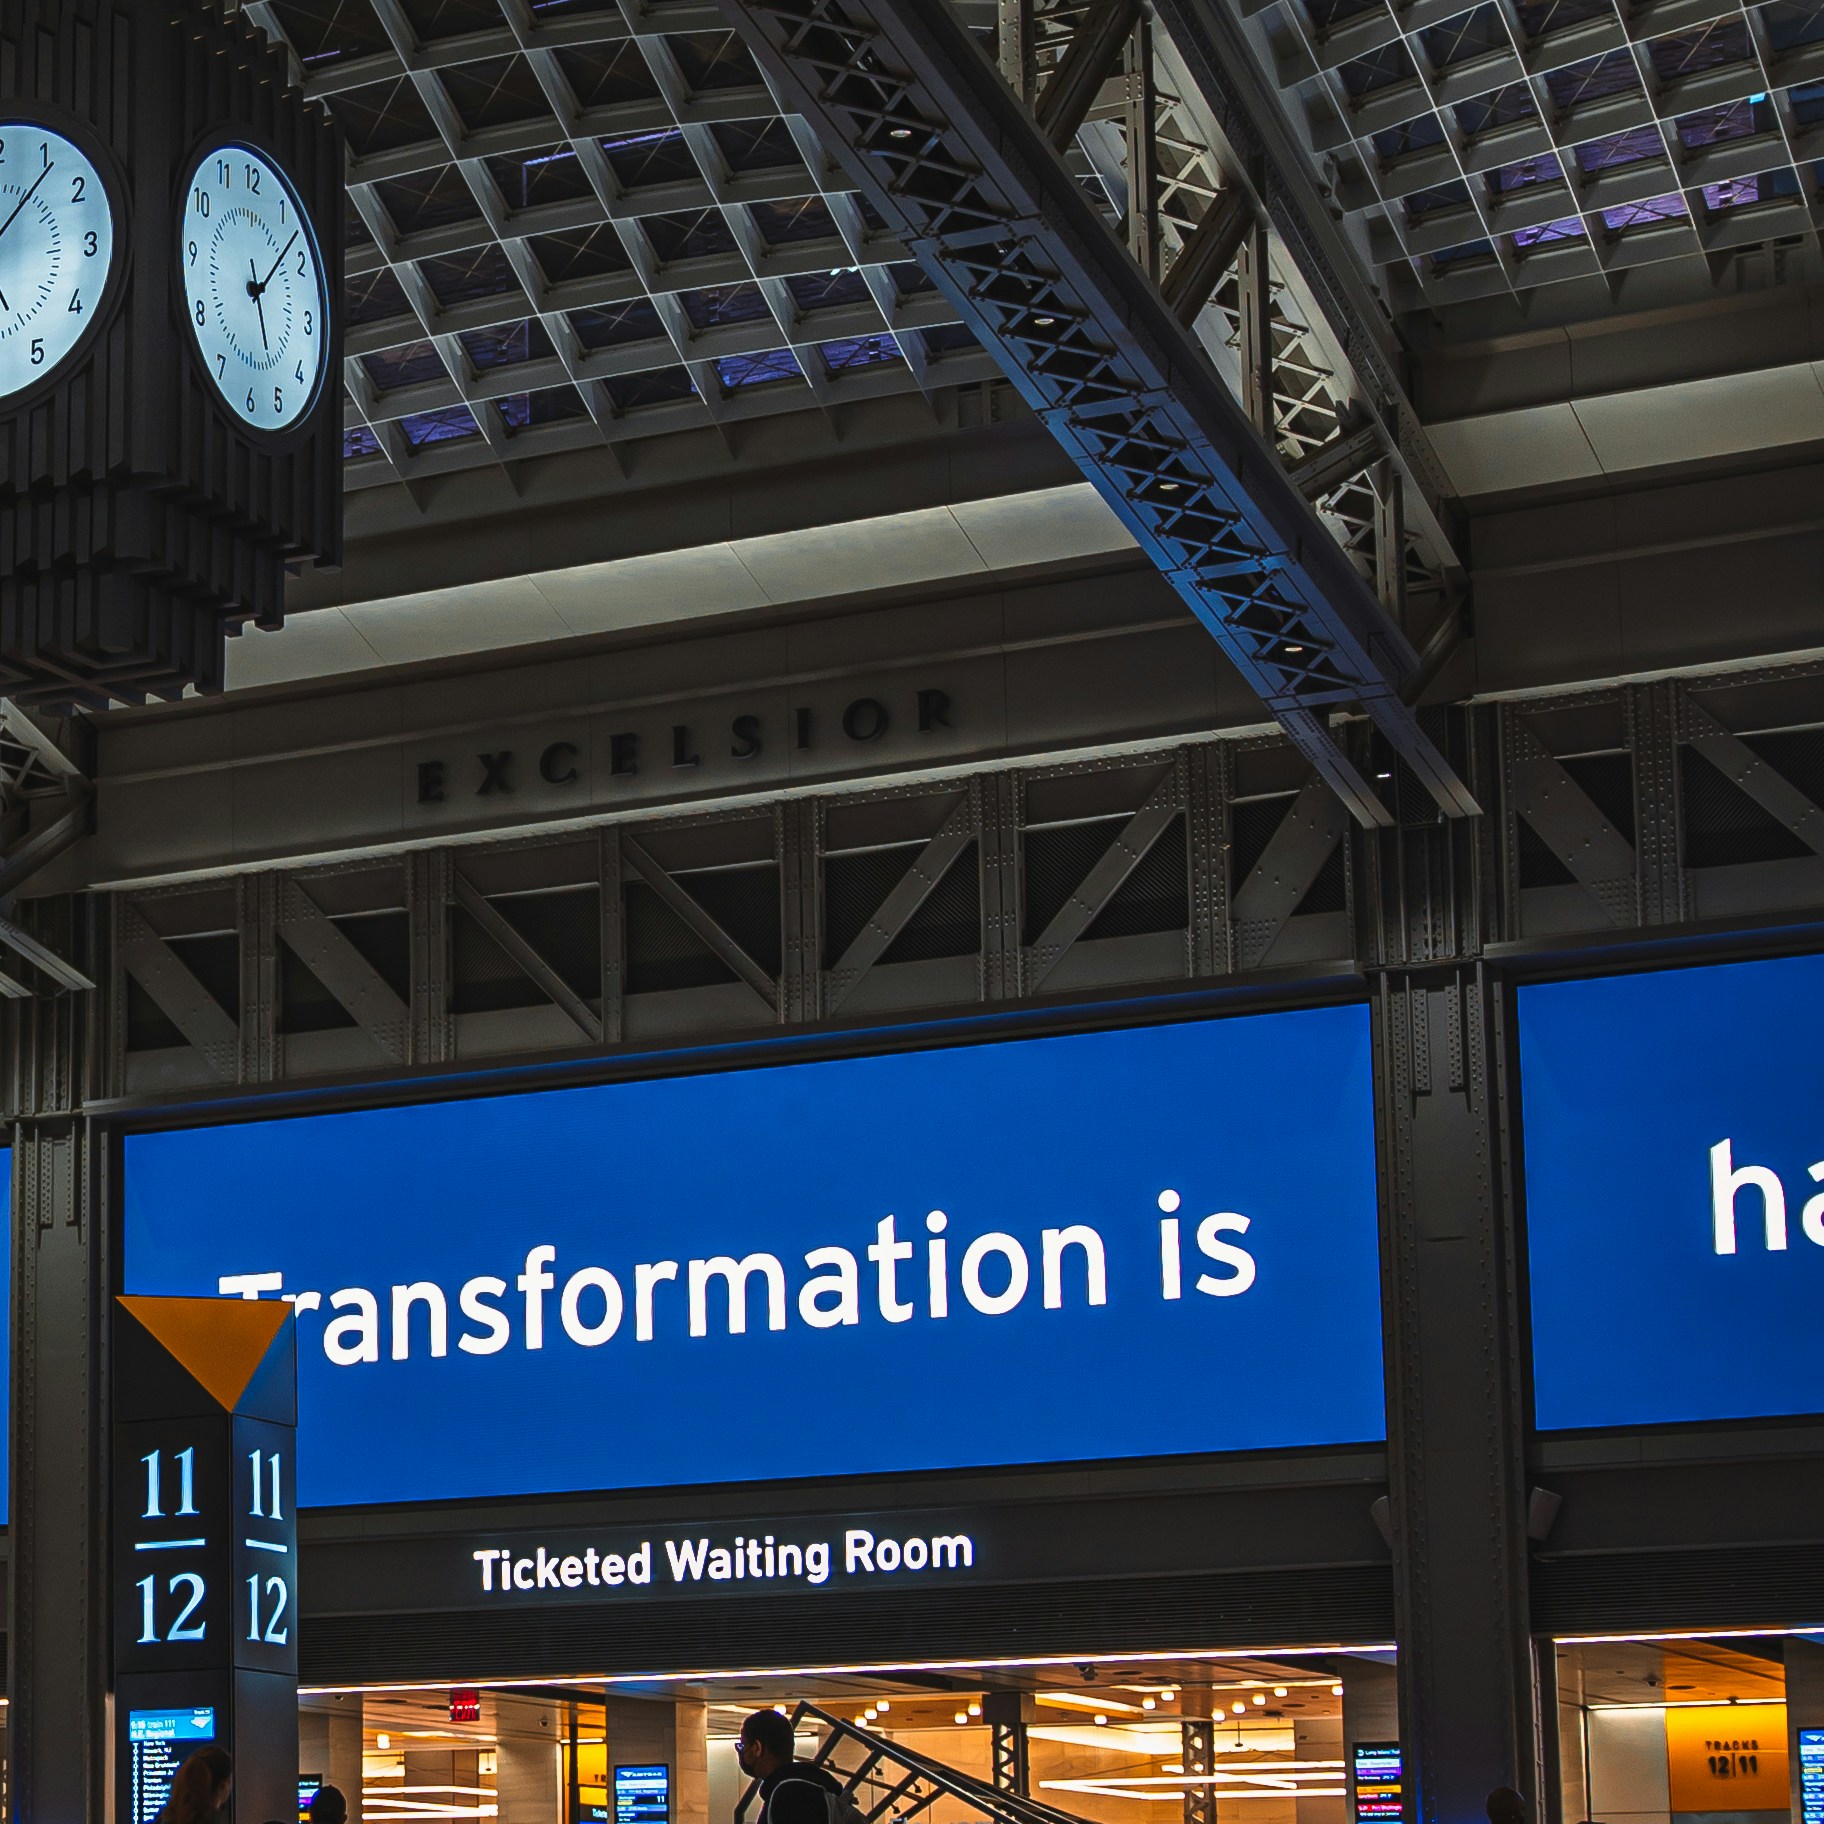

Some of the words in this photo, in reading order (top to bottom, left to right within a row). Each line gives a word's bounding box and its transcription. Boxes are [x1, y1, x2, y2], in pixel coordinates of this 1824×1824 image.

[39, 142, 48, 168] 1
[216, 159, 230, 189] 11
[244, 164, 261, 195] 12
[71, 176, 86, 203] 2
[193, 187, 210, 218] 10
[279, 199, 285, 224] 1
[83, 231, 98, 257] 3
[188, 241, 197, 266] 9
[296, 250, 306, 277] 2
[67, 288, 83, 314] 4
[195, 300, 205, 326] 8
[303, 310, 313, 336] 3
[30, 338, 44, 364] 5
[216, 353, 227, 380] 7
[294, 359, 304, 384] 4
[246, 387, 255, 413] 6
[274, 386, 283, 413] 5
[417, 688, 953, 804] EXCELSIOR
[1157, 1189, 1256, 1300] is
[140, 1446, 200, 1518] 11
[249, 1449, 284, 1521] 11
[472, 1542, 651, 1591] Ticketed
[664, 1535, 830, 1584] Waiting
[845, 1529, 973, 1573] Room
[136, 1573, 206, 1644] 12
[246, 1573, 288, 1645] 12
[1705, 1739, 1759, 1751] TRACKS
